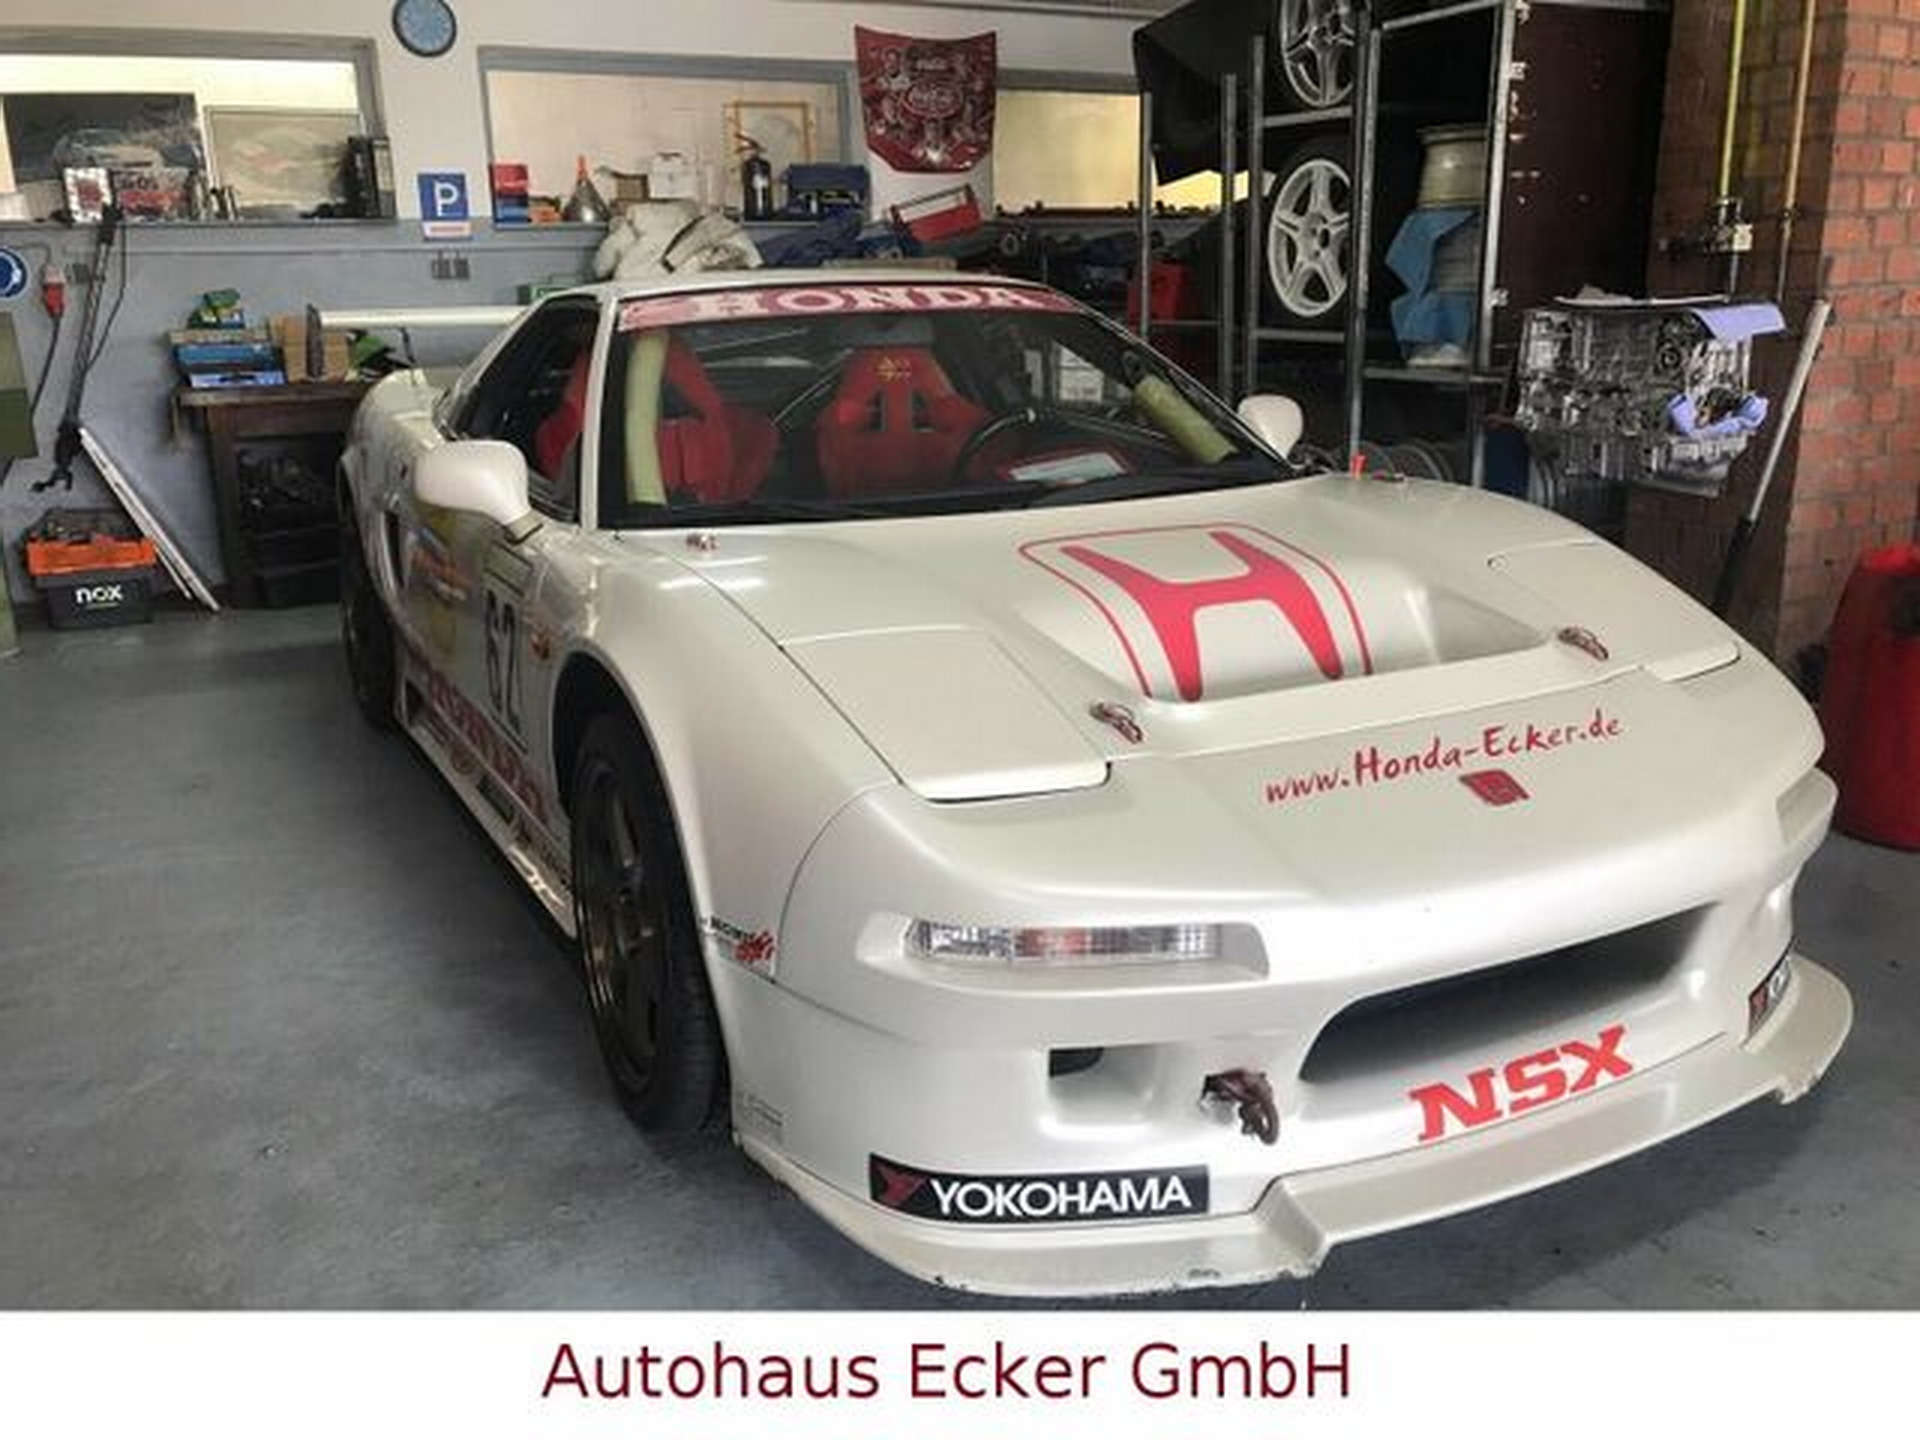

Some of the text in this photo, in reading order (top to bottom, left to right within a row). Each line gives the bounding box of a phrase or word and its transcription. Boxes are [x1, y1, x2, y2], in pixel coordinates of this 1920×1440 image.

[434, 181, 458, 217] P
[699, 286, 1046, 321] HONDA
[76, 585, 123, 603] nox
[1266, 708, 1624, 804] www.Honda-Ecker.de
[1408, 1024, 1633, 1141] NSX
[931, 1175, 1191, 1217] YOKOHAMA
